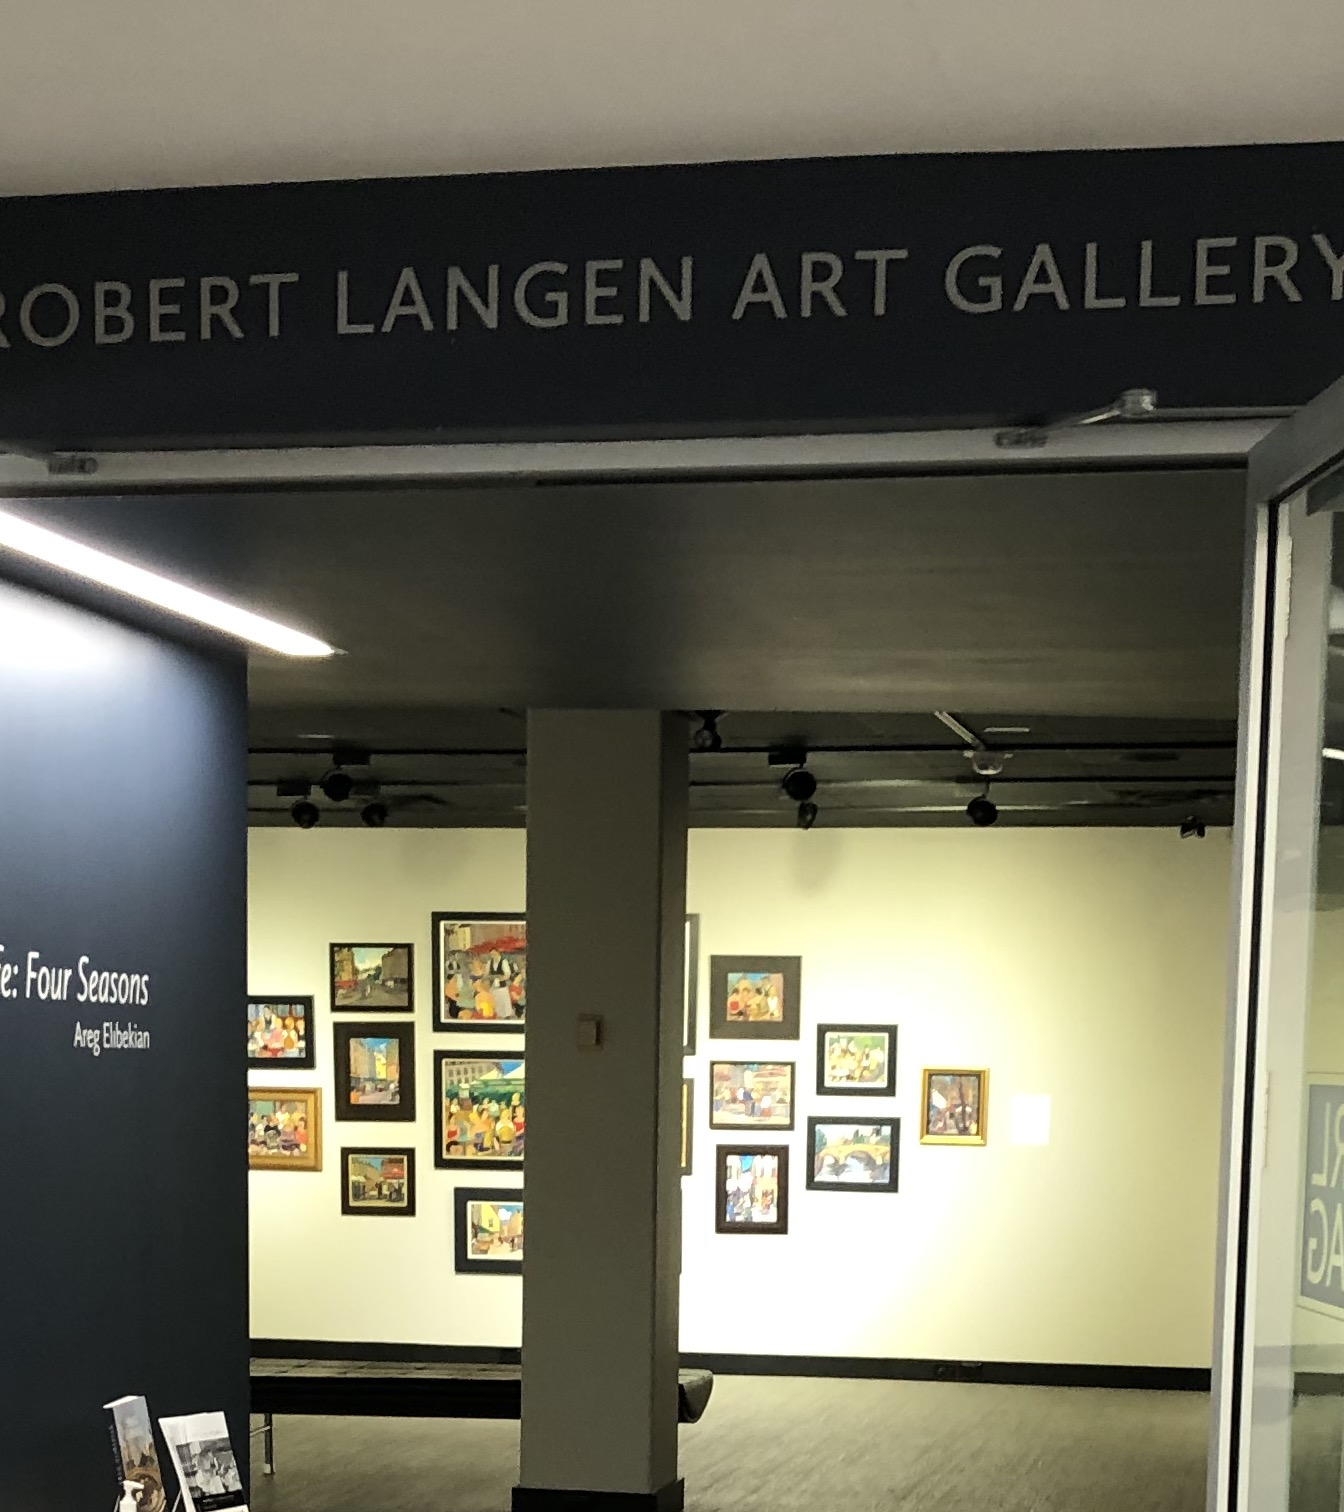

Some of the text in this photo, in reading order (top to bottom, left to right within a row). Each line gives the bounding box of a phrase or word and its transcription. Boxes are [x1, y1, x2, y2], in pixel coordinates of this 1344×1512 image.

[336, 256, 694, 335] LANGEN
[731, 248, 909, 320] ART
[25, 951, 73, 1000] Four
[76, 955, 150, 1006] Seasons
[73, 1020, 101, 1057] Areg
